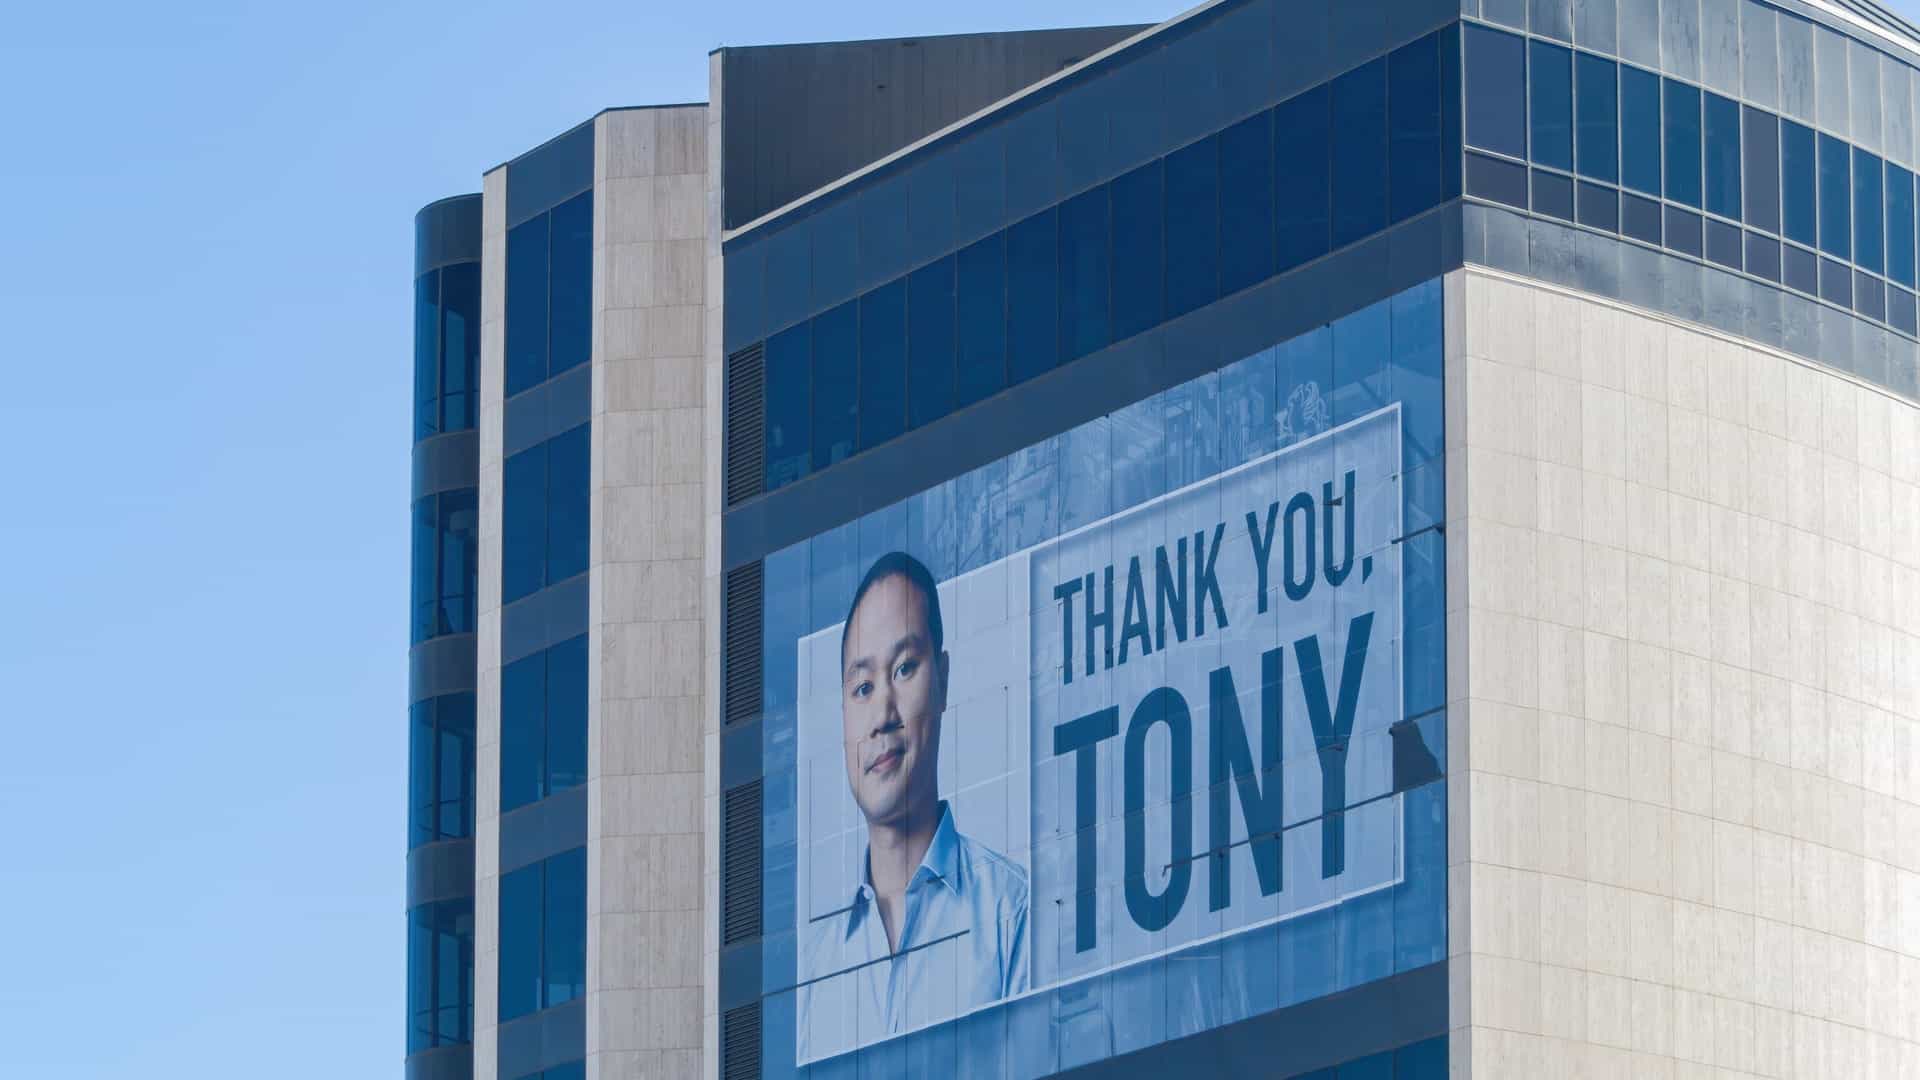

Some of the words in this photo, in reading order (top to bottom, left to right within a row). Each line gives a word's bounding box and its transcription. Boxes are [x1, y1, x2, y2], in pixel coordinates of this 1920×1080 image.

[1053, 521, 1229, 685] THANK
[1245, 470, 1374, 615] YOU,
[1053, 611, 1375, 954] TONY
